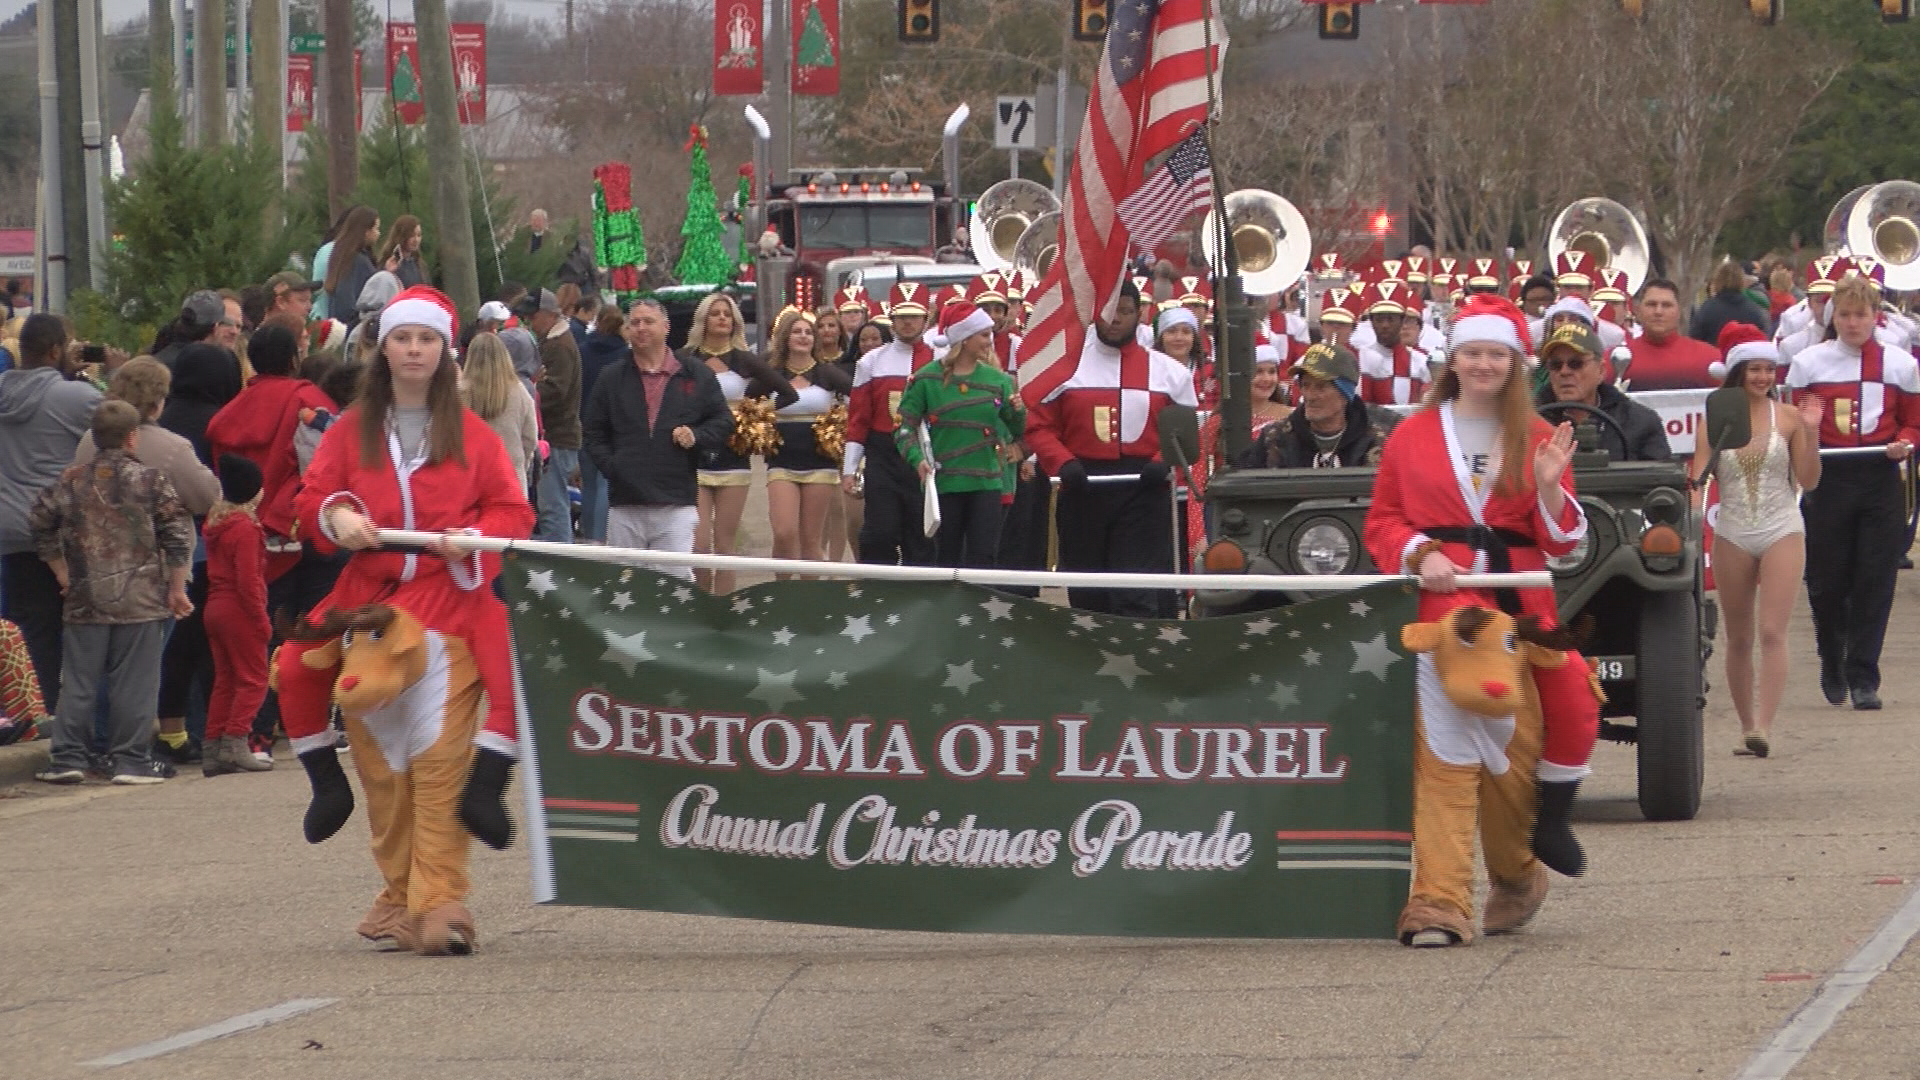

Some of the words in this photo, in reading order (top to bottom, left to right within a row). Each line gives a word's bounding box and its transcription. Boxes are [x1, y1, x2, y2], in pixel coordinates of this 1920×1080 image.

[571, 690, 928, 777] SERTOMA
[936, 722, 1041, 778] OF
[1055, 717, 1349, 780] LAUREL
[659, 783, 826, 860] Annual
[827, 793, 1063, 870] Christmas
[1069, 799, 1254, 878] Parade
